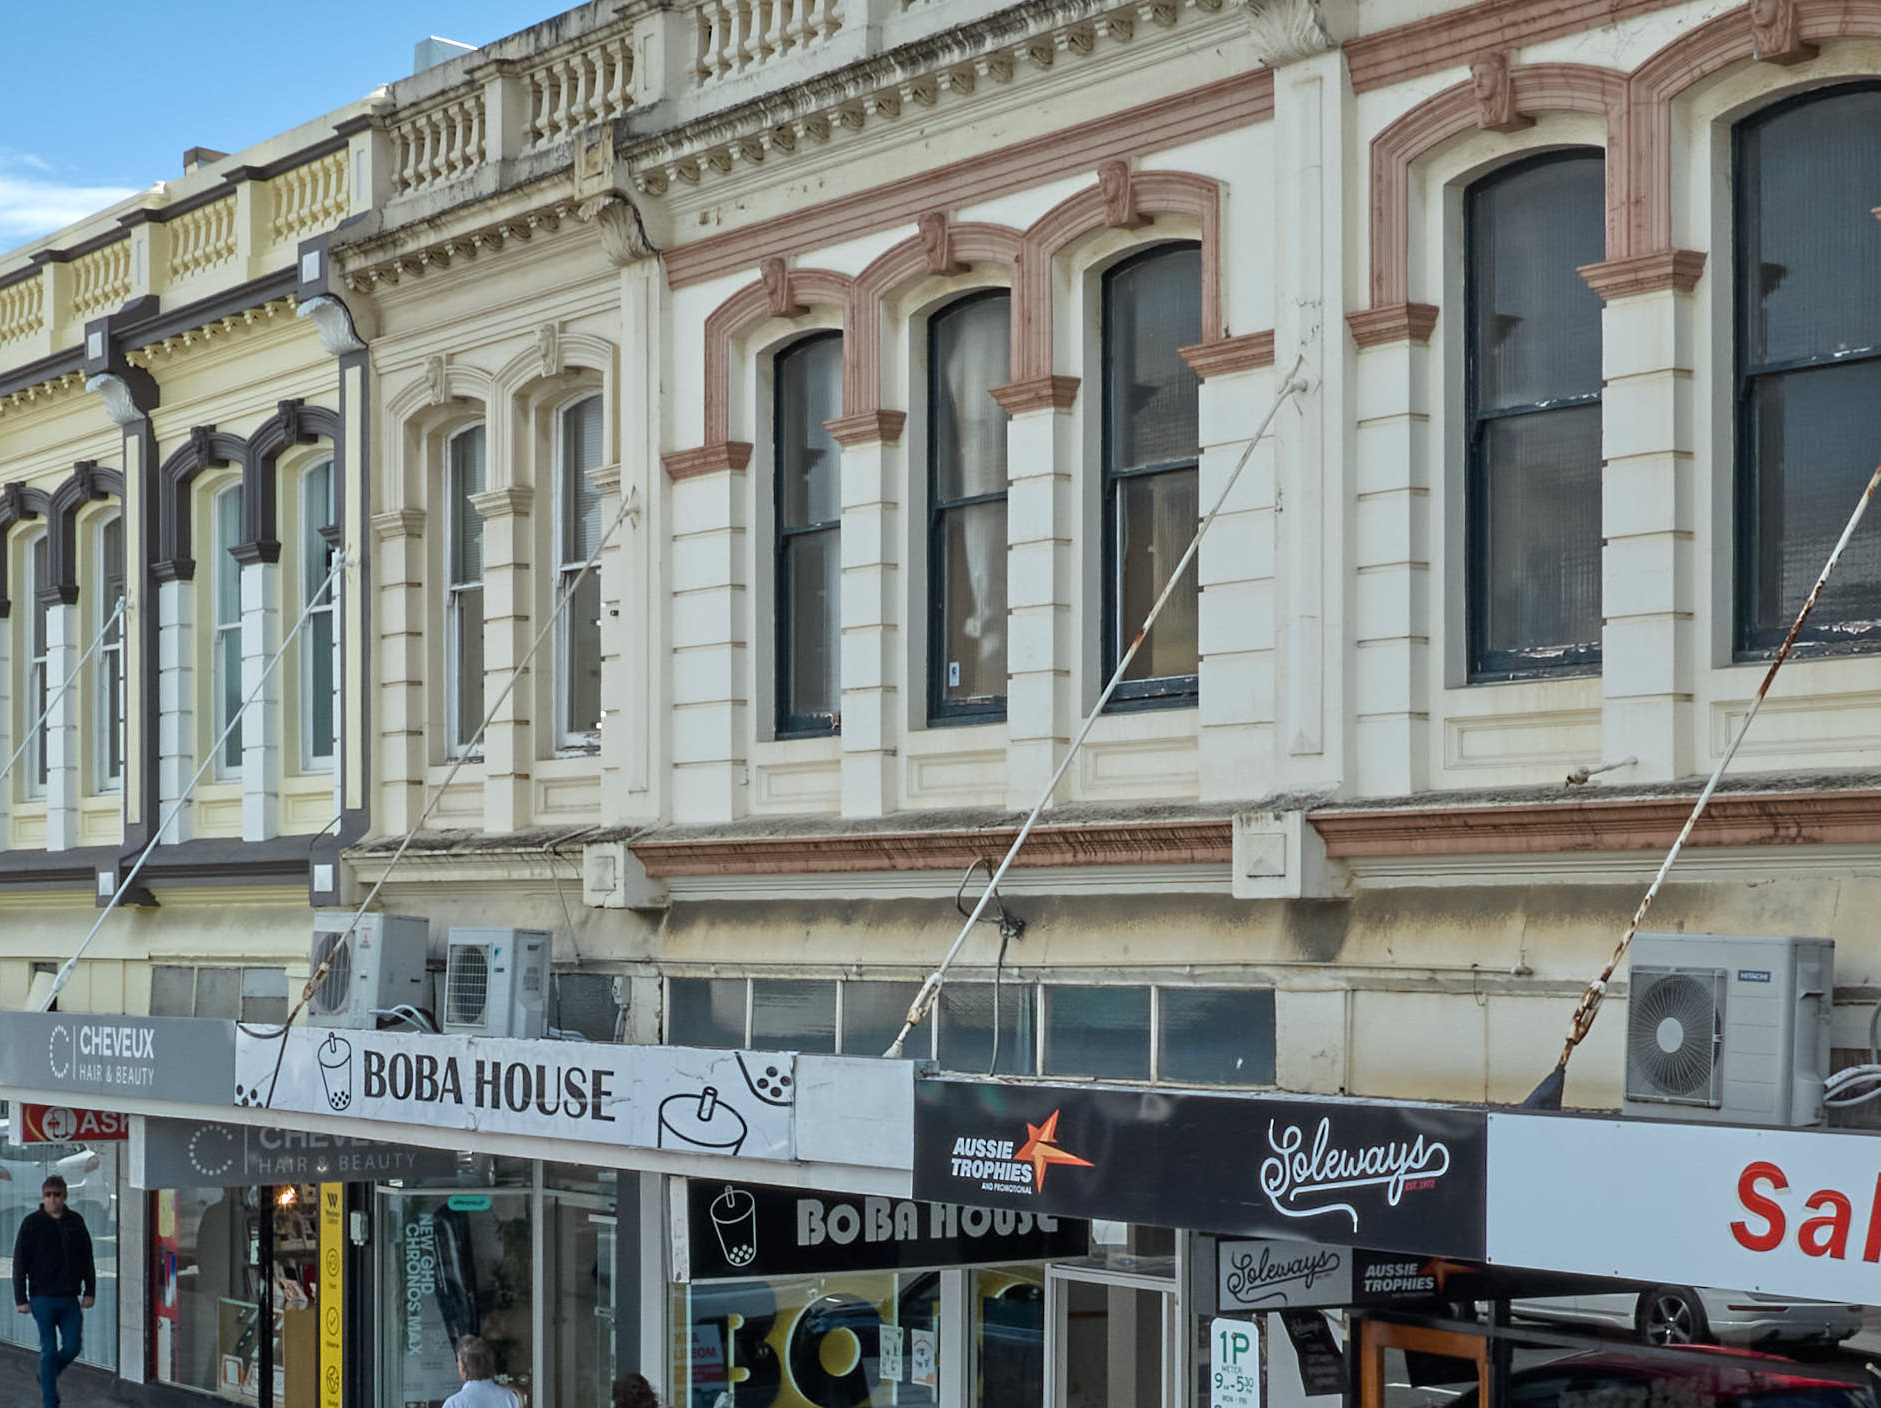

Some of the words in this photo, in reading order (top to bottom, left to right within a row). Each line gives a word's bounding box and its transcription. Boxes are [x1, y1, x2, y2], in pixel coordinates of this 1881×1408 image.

[79, 1025, 155, 1059] CHEVEUX
[79, 1063, 103, 1082] HAIR
[105, 1065, 113, 1083] &
[116, 1066, 155, 1086] BEAUTY
[364, 1050, 464, 1105] BOBA
[475, 1060, 616, 1122] HOUSE
[259, 1156, 308, 1174] HAIR
[339, 1151, 417, 1172] BEAUTY
[952, 1137, 1014, 1160] AUSSIE
[951, 1158, 1032, 1183] TROPHIES
[1260, 1117, 1450, 1233] Soleways
[420, 1213, 434, 1248] NEW
[796, 1196, 918, 1247] BOBA
[405, 1223, 421, 1312] CHRONOS
[420, 1249, 435, 1294] GHD
[1227, 1246, 1340, 1304] Soleways
[1364, 1276, 1435, 1292] TROPHIES
[1365, 1263, 1419, 1277] AUSSIE
[407, 1314, 422, 1355] MAX
[1219, 1330, 1250, 1365] 1P
